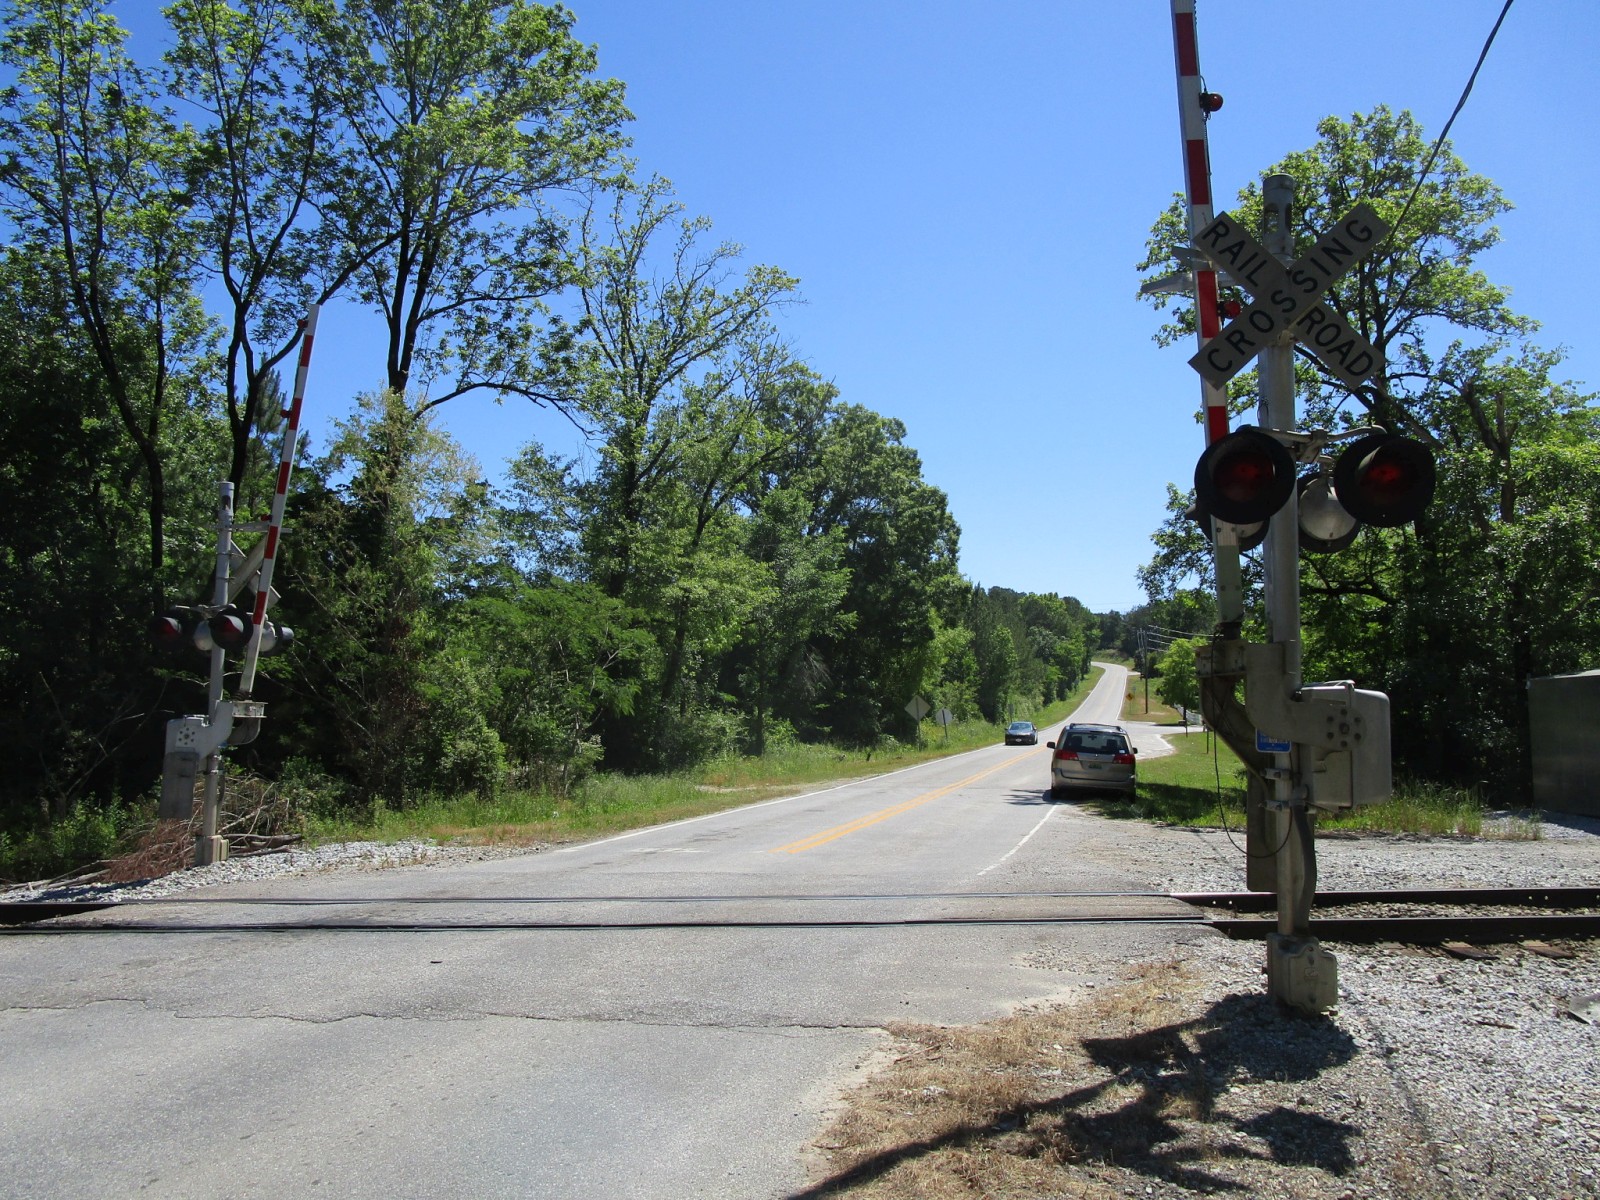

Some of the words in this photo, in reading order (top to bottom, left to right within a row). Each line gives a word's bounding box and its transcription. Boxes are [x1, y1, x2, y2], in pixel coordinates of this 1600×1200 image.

[1202, 220, 1268, 288] RAIL
[1297, 306, 1374, 377] ROAD
[1207, 219, 1373, 373] CROSSING
